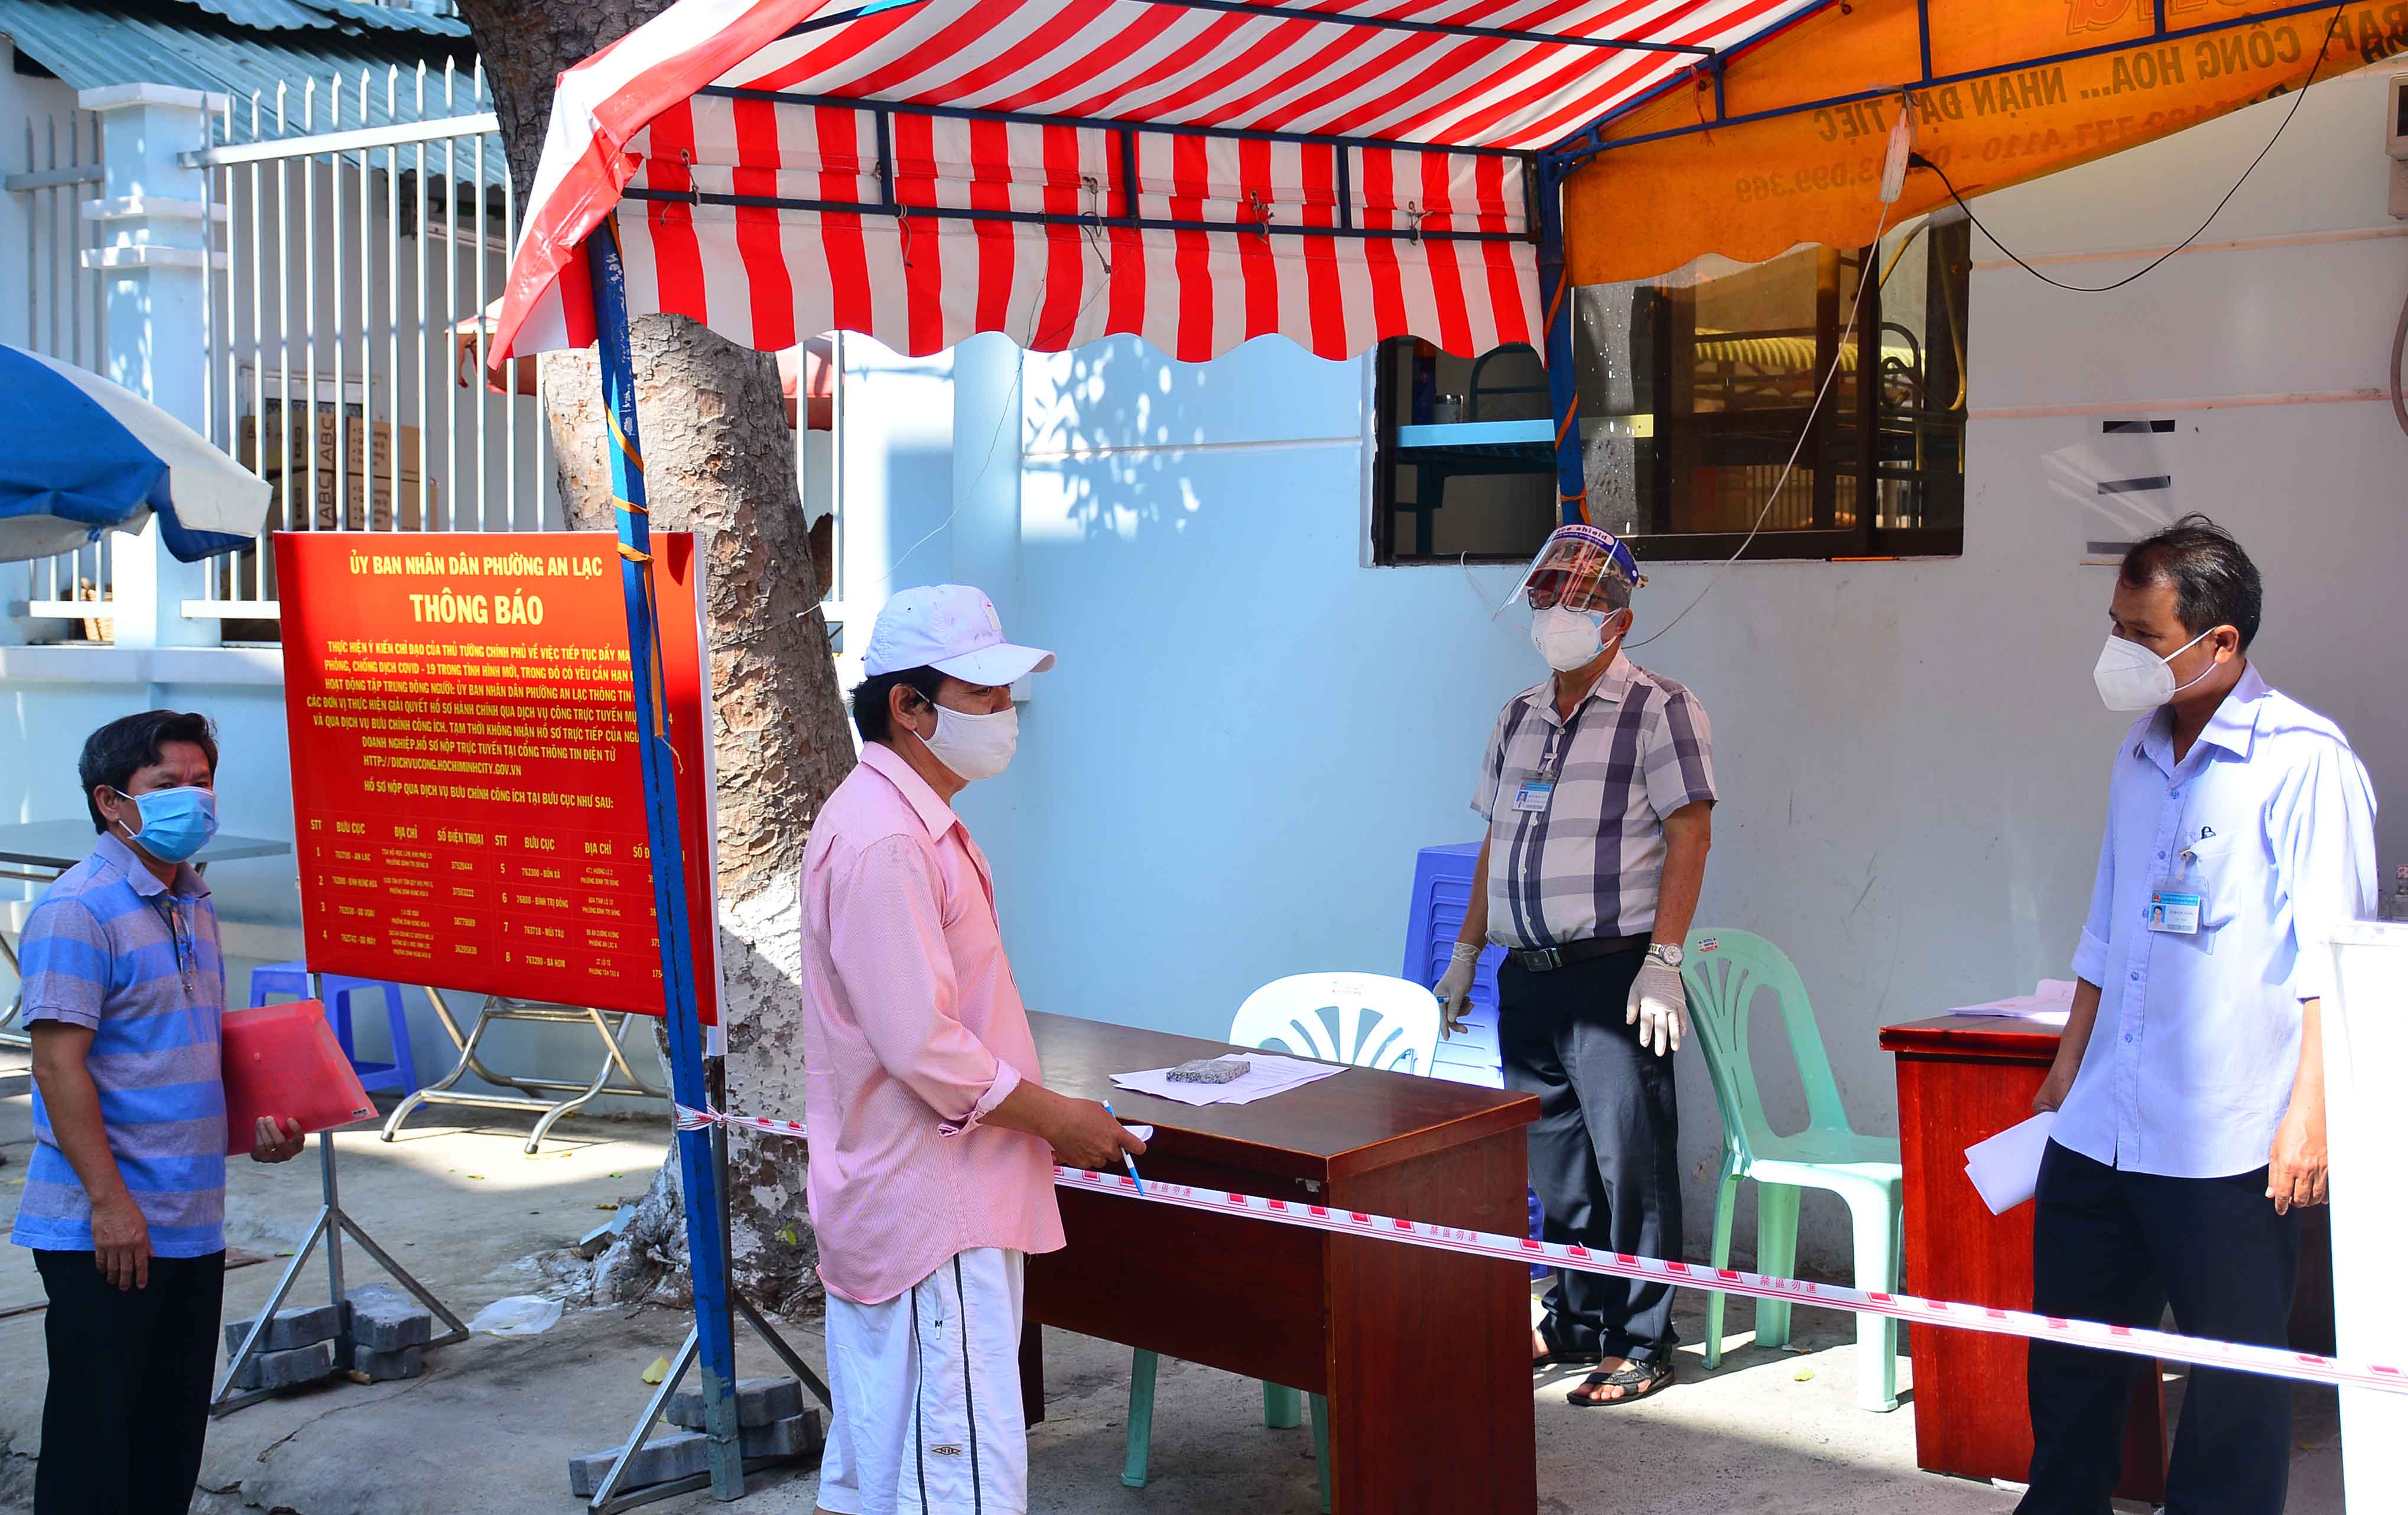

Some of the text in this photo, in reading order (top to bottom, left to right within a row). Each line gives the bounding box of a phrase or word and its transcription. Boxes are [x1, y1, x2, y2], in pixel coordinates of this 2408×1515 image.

[1576, 526, 1607, 540] shield
[350, 549, 603, 580] ỦY BAN NHÂN DÂN PHƯỜNG AN LẠC
[409, 587, 544, 625] THÔNG BÁO
[349, 639, 367, 655] HIỆN
[375, 639, 394, 654] KIẾN
[409, 643, 424, 657] ĐẠO
[425, 640, 441, 656] CỦA
[442, 641, 457, 657] THỦ
[486, 644, 509, 658] CHÍNH
[511, 643, 526, 659] PHỦ
[541, 645, 560, 662] VIỆC
[561, 643, 579, 660] TIẾP
[581, 649, 597, 664] TỤC
[599, 643, 615, 661] ĐẨY
[353, 657, 378, 672] CHỐNG
[379, 661, 397, 675] DỊCH
[398, 662, 420, 674] COVID
[427, 663, 436, 675] 19
[437, 664, 462, 676] TRONG
[463, 662, 480, 677] TÌNH
[482, 663, 500, 677] HÌNH
[521, 667, 546, 679] TRONG
[548, 665, 560, 680] ĐÓ
[562, 665, 573, 680] CÓ
[575, 666, 590, 681] YÊU
[592, 664, 609, 681] CẦN
[611, 670, 628, 683] HẠN
[368, 677, 382, 693] TẬP
[384, 681, 408, 693] TRUNG
[457, 680, 467, 695] ỦY
[469, 684, 483, 695] BAN
[486, 682, 506, 697] NHÂN
[508, 683, 524, 697] DÂN
[526, 684, 558, 699] PHƯỜNG
[560, 688, 570, 699] AN
[573, 689, 587, 702] LẠC
[589, 687, 616, 701] THÔNG
[618, 690, 631, 702] TIN
[307, 692, 321, 707] CÁC
[369, 697, 386, 713] HIỆN
[405, 697, 427, 713] QUYẾT
[443, 702, 452, 714] SƠ
[454, 701, 474, 715] HÀNH
[476, 702, 498, 716] CHÍNH
[501, 706, 515, 719] QUA
[517, 706, 535, 720] DỊCH
[538, 708, 547, 720] VỤ
[550, 705, 571, 719] CÔNG
[573, 707, 594, 723] TRỰC
[596, 706, 622, 722] TUYẾN
[313, 713, 323, 726] VÀ
[326, 716, 339, 728] QUA
[341, 717, 358, 730] DỊCH
[359, 717, 369, 731] VỤ
[388, 717, 410, 730] CHÍNH
[412, 718, 432, 732] CÔNG
[449, 722, 466, 736] TẠM
[486, 722, 512, 736] KHÔNG
[514, 723, 535, 738] NHẬN
[551, 727, 561, 739] SƠ
[563, 727, 583, 742] TRỰC
[585, 725, 603, 741] TIẾP
[605, 726, 622, 742] CỦA
[362, 736, 386, 748] DOANH
[429, 739, 438, 751] SƠ
[440, 739, 454, 754] NỘP
[457, 741, 476, 756] TRỰC
[478, 740, 502, 755] TUYẾN
[503, 745, 516, 758] TẠI
[541, 745, 567, 759] THÔNG
[569, 748, 581, 759] TIN
[584, 746, 603, 762] ĐIỆN
[605, 745, 616, 762] TỬ
[377, 781, 386, 792] SƠ
[388, 779, 402, 795] NỘP
[404, 783, 418, 796] QUA
[421, 784, 437, 798] DỊCH
[440, 785, 448, 799] VỤ
[467, 785, 489, 799] CHÍNH
[491, 787, 510, 802] CÔNG
[512, 788, 525, 802] ÍCH
[527, 792, 540, 806] TẠI
[542, 792, 558, 805] BƯU
[560, 794, 575, 808] CỤC
[577, 795, 593, 807] NHƯ
[595, 796, 613, 809] SAU:
[311, 820, 321, 830] STT
[352, 822, 365, 835] CỤC
[394, 826, 405, 840] ĐỊA
[437, 827, 483, 847] SỐ ĐIỆN THOẠI
[495, 835, 507, 846] STT
[524, 835, 555, 852] BƯU CỤC
[585, 839, 612, 856] ĐỊA CHỈ
[633, 843, 642, 858] SỐ
[316, 847, 320, 856] 1
[501, 863, 505, 873] 5
[319, 875, 323, 885] 2
[502, 892, 507, 903] 6
[323, 929, 327, 939] 4
[503, 922, 509, 932] 7
[506, 952, 511, 962] 8
